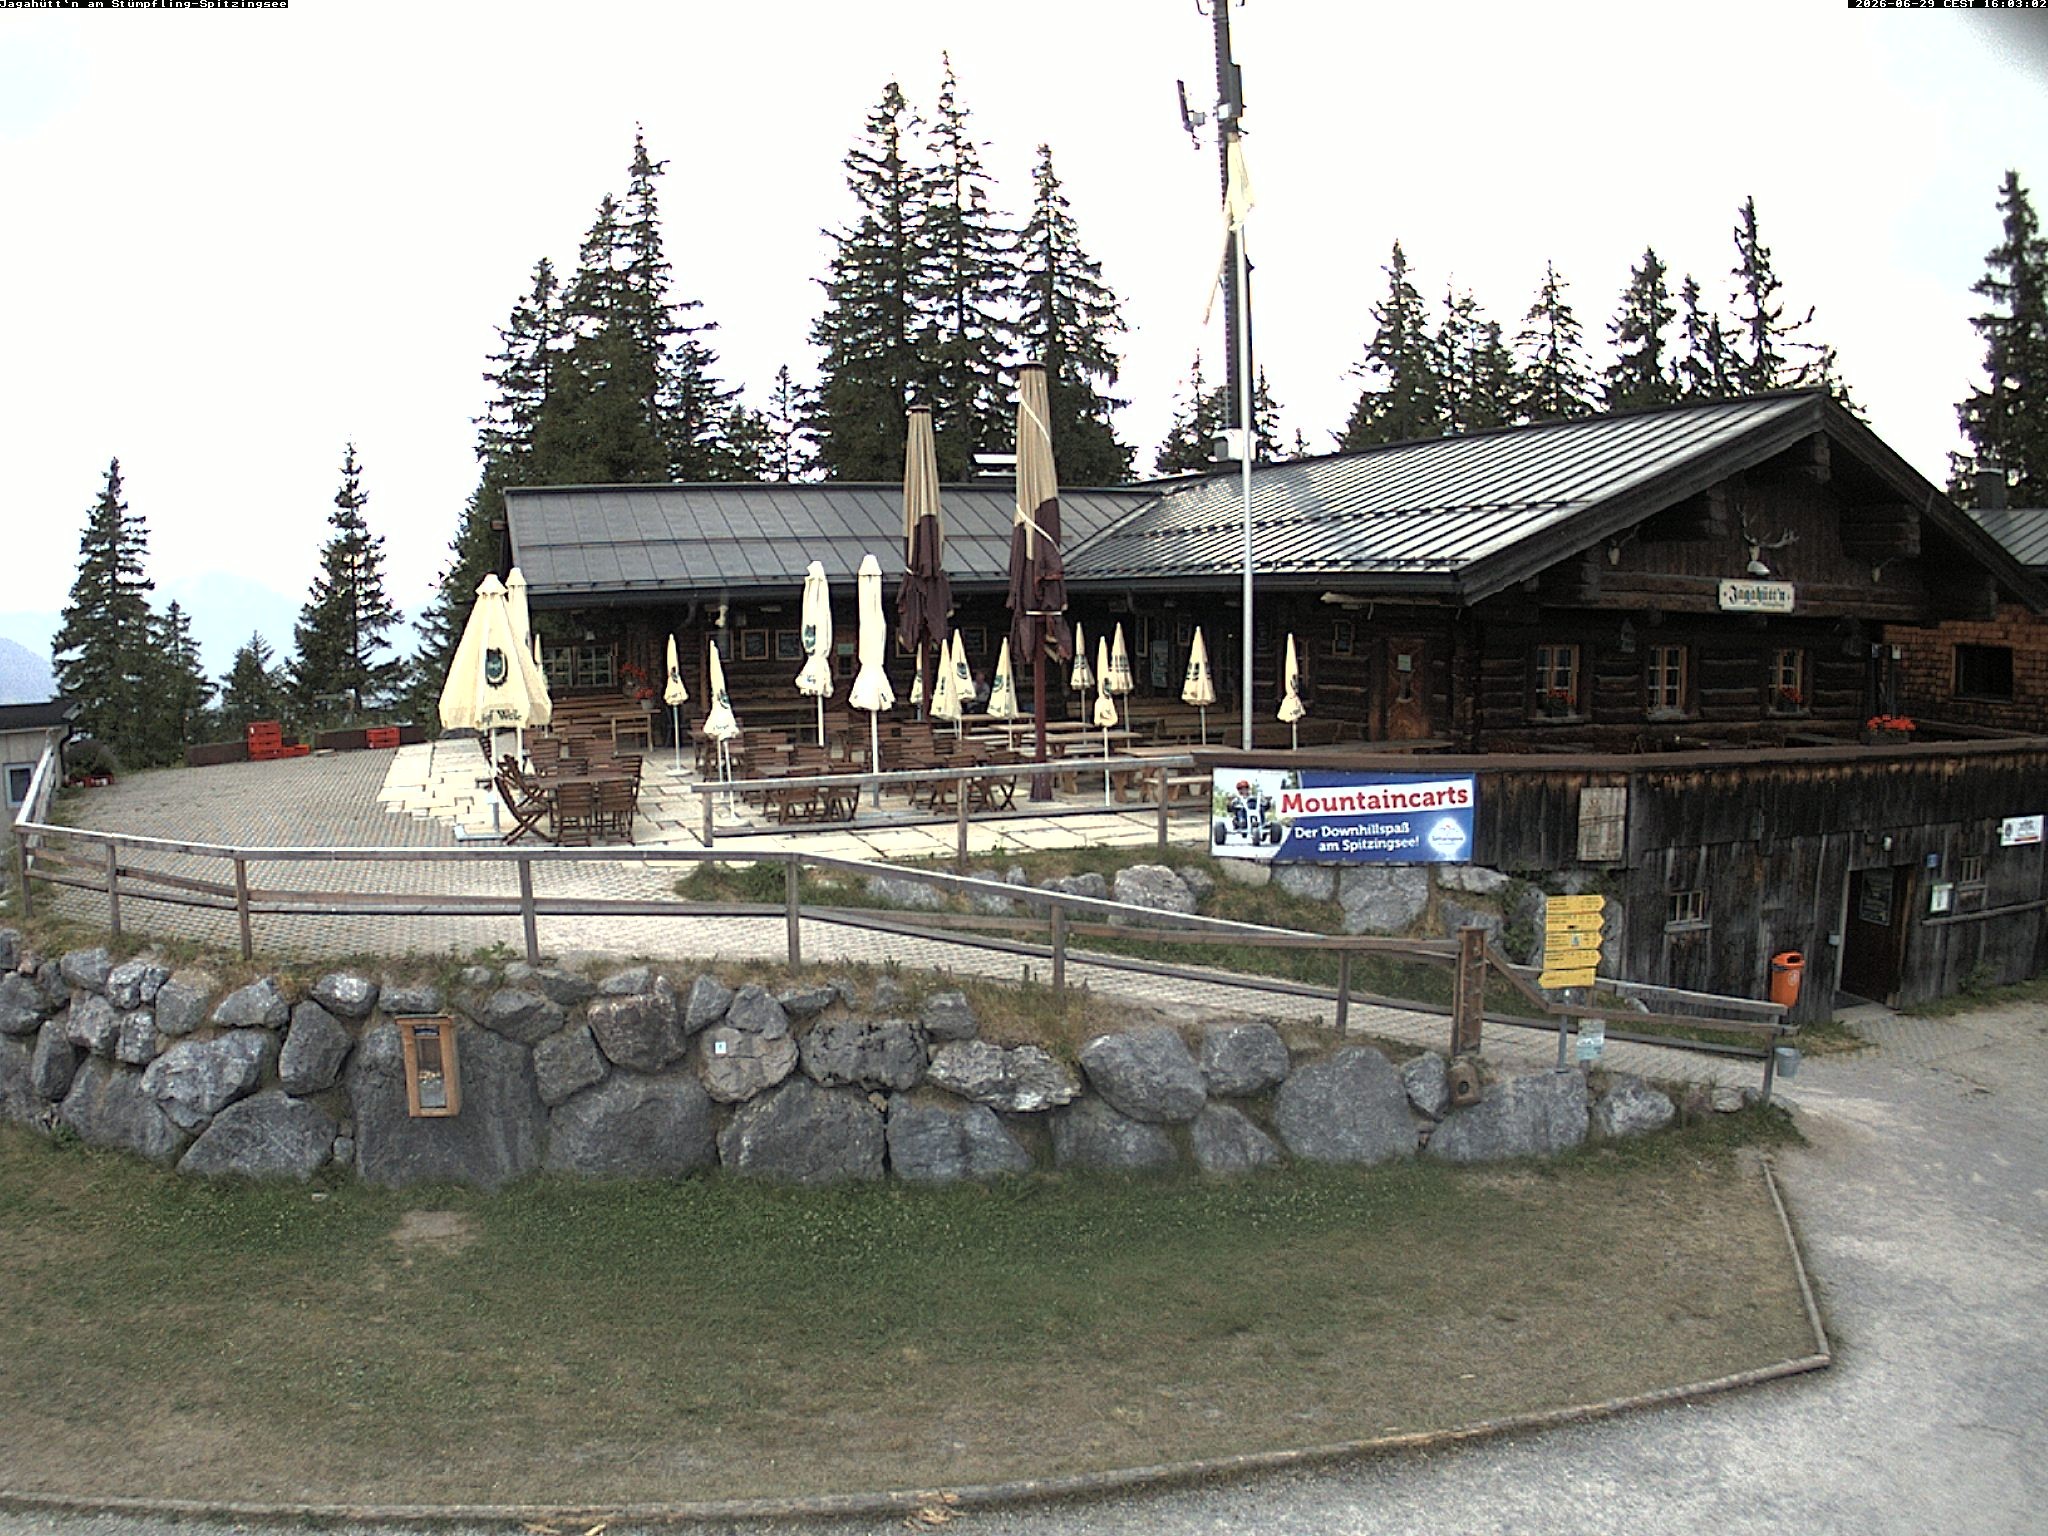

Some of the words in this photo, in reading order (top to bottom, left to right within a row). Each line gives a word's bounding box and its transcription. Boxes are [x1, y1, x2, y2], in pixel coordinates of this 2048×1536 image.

[1281, 786, 1469, 813] Mountaincarts
[1295, 826, 1319, 839] Der
[1321, 821, 1410, 838] Downhillspaß
[1318, 841, 1340, 852] am
[1342, 836, 1420, 854] Spitzingsee!
